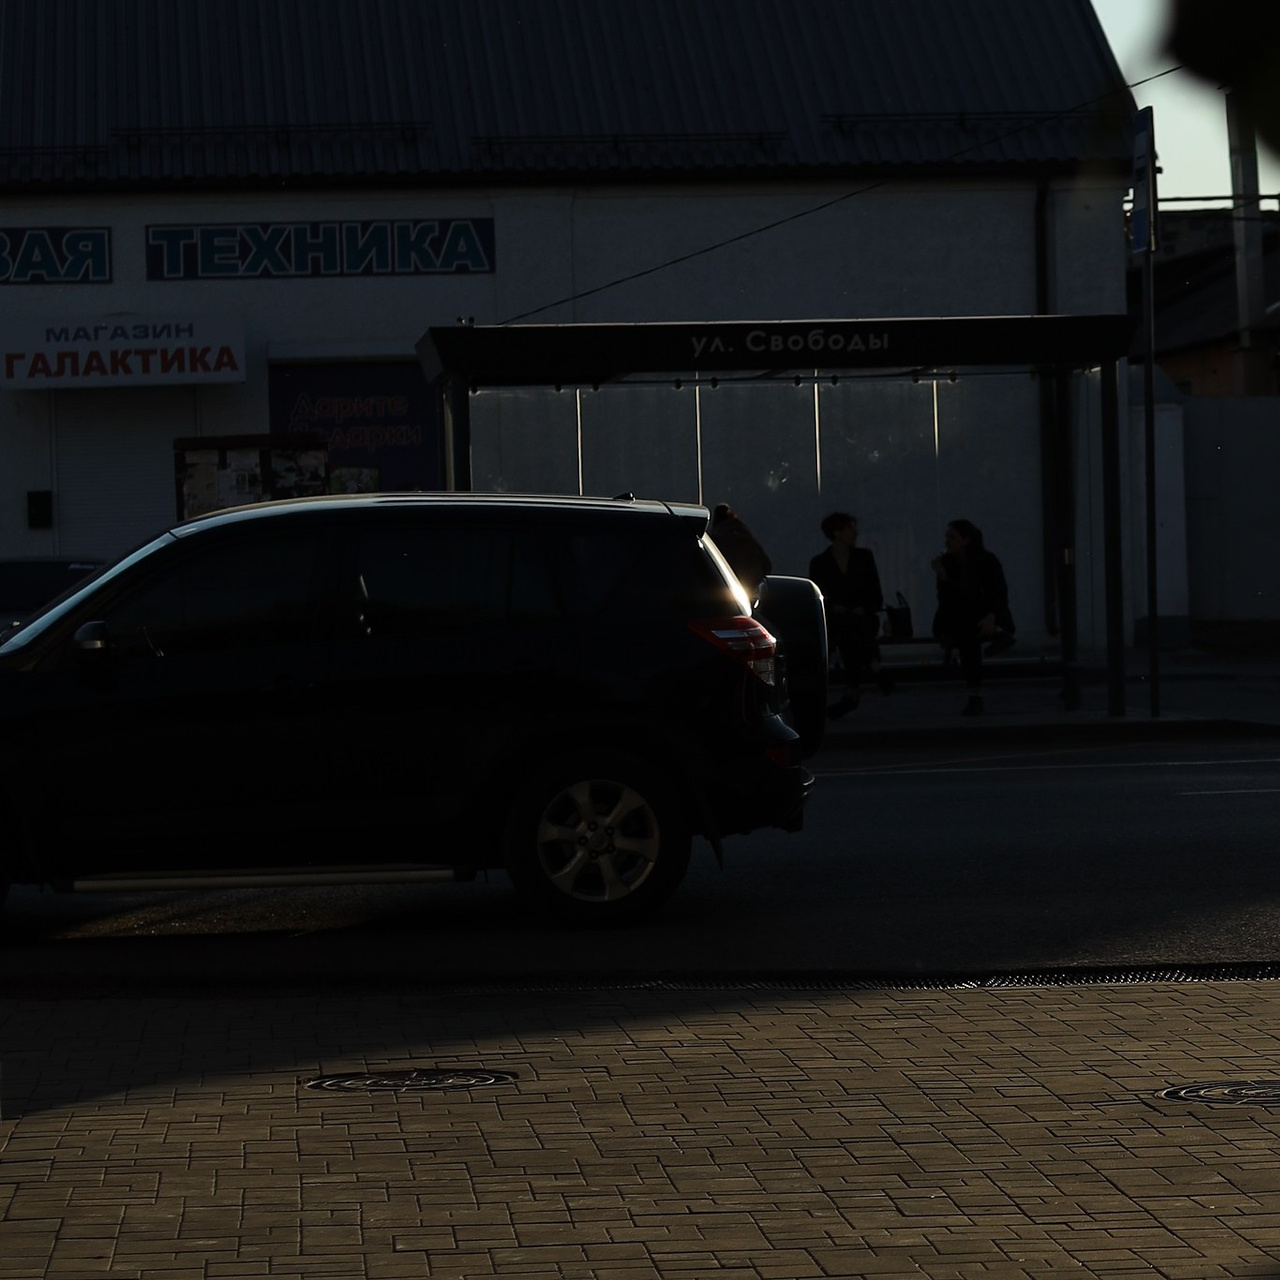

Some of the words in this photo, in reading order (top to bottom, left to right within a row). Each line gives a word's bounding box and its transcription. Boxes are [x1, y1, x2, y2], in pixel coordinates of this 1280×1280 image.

[149, 220, 490, 279] ТЕХНИКА
[45, 322, 194, 343] МАГАЗИН
[691, 336, 734, 358] ул.
[745, 329, 889, 352] Свободы
[4, 345, 239, 380] ГАЛАКТИКА
[290, 392, 409, 424] Дарите
